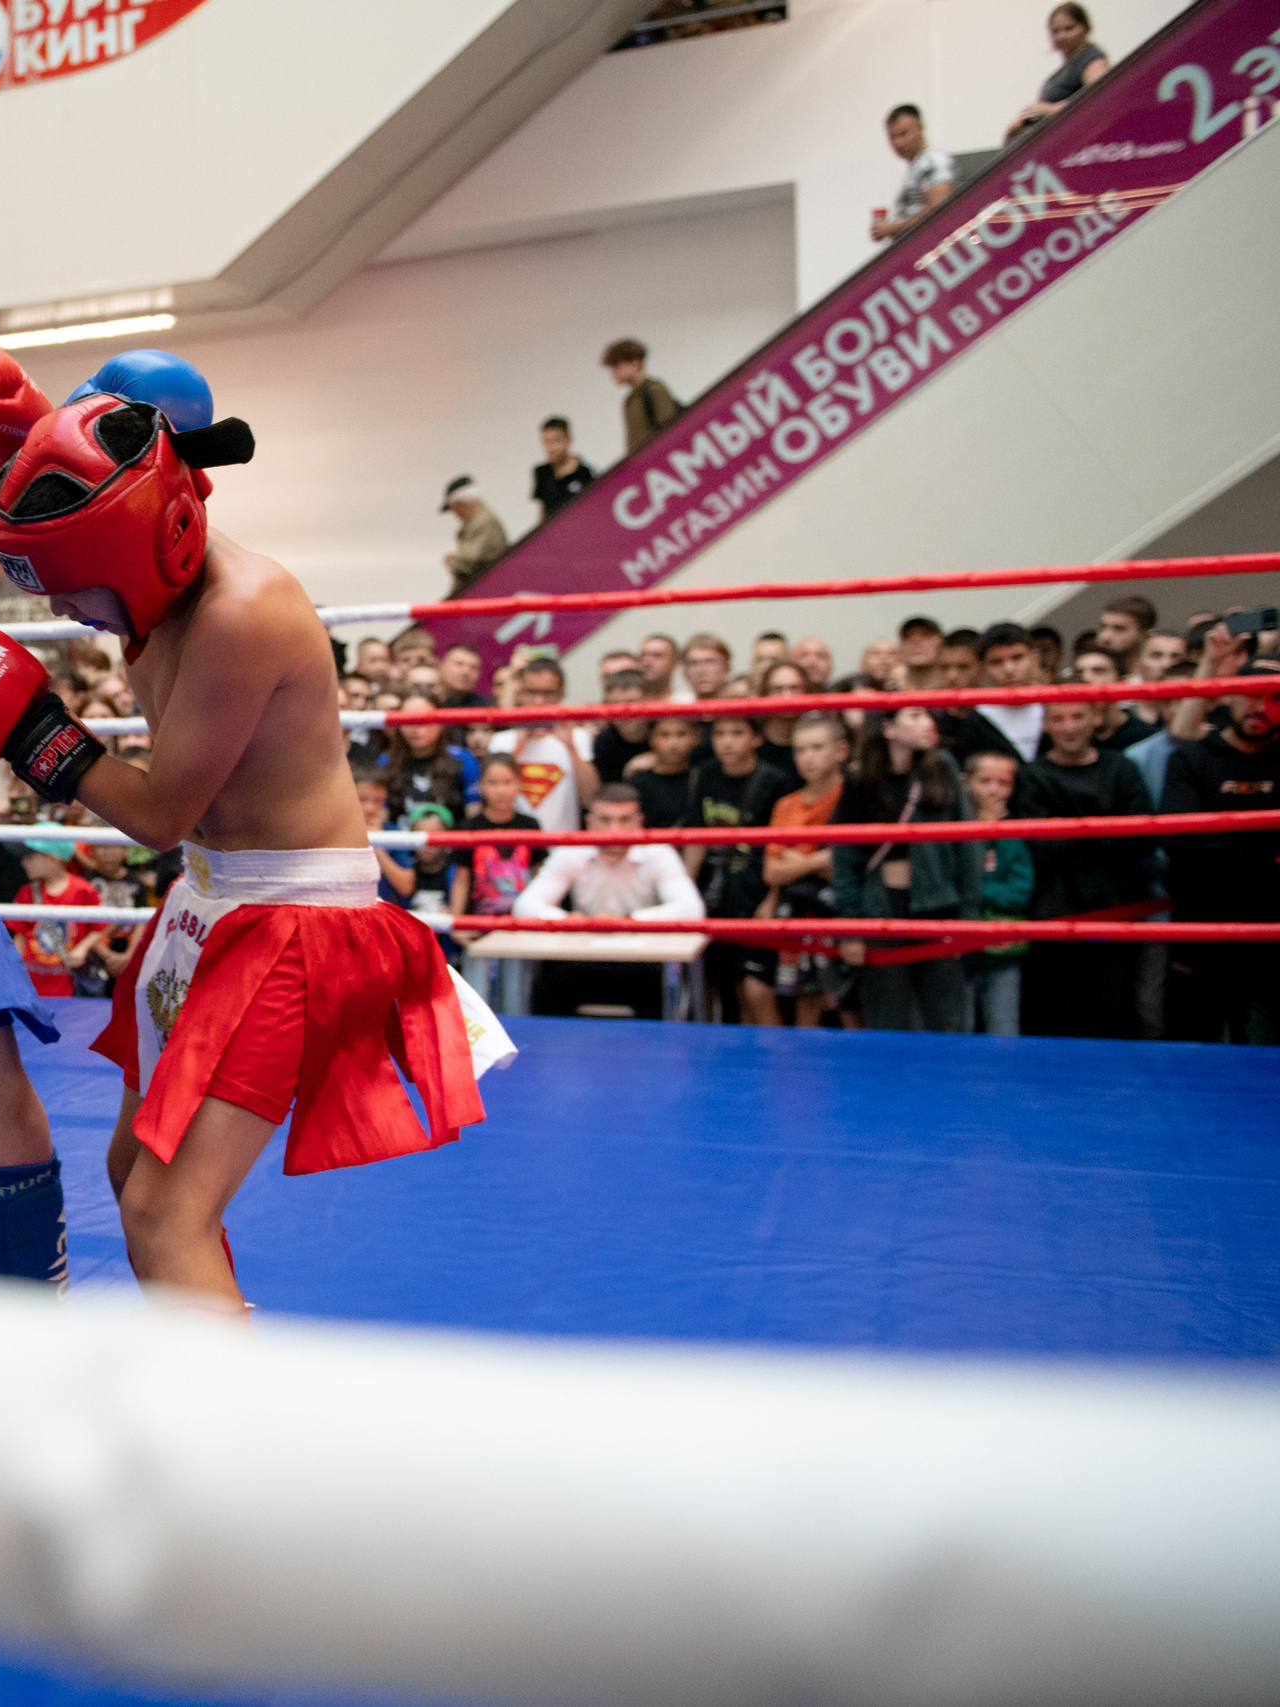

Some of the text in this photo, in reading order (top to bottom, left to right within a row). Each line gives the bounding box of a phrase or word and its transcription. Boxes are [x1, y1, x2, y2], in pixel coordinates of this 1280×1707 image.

[14, 7, 146, 76] КИНГ
[1157, 62, 1244, 145] 2
[612, 159, 1072, 530] САМЫЙ БОЛЬШОЙ
[620, 454, 783, 587] МАГАЗИН
[772, 315, 954, 464] ОБУВИ
[28, 724, 86, 782] TOPTEN
